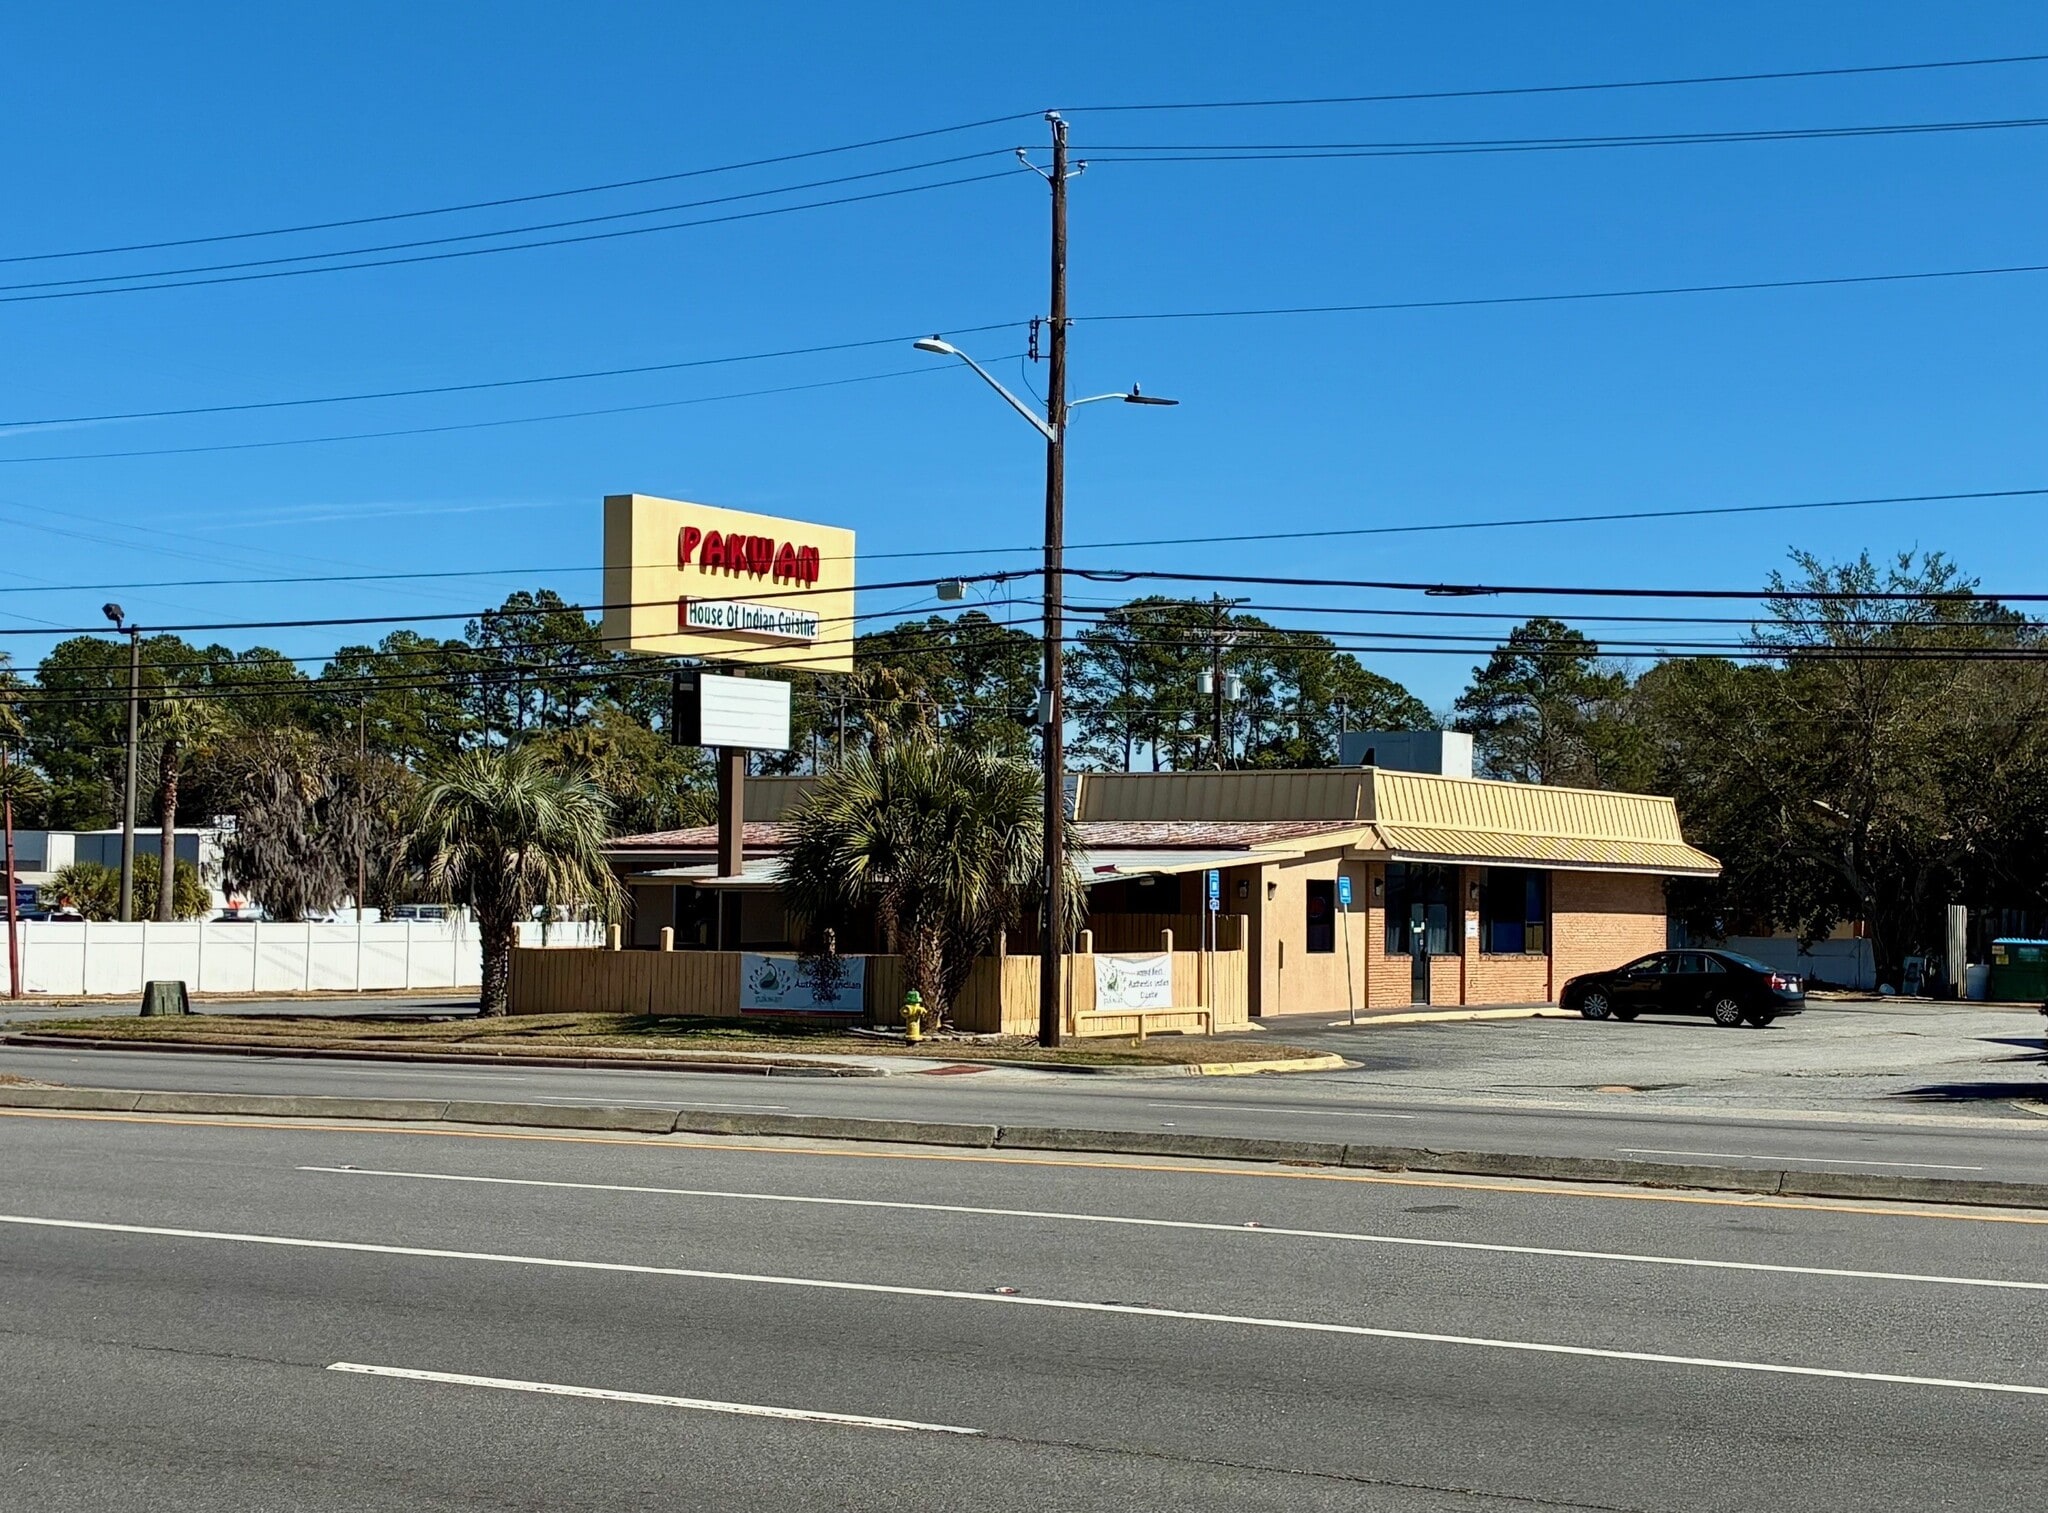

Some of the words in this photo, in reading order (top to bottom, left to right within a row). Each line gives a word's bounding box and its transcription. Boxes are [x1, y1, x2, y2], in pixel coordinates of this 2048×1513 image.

[678, 526, 820, 588] PAKWAN
[689, 600, 723, 626] House
[727, 604, 739, 629] Of
[742, 606, 775, 632] Indian
[779, 611, 816, 637] Cuisine
